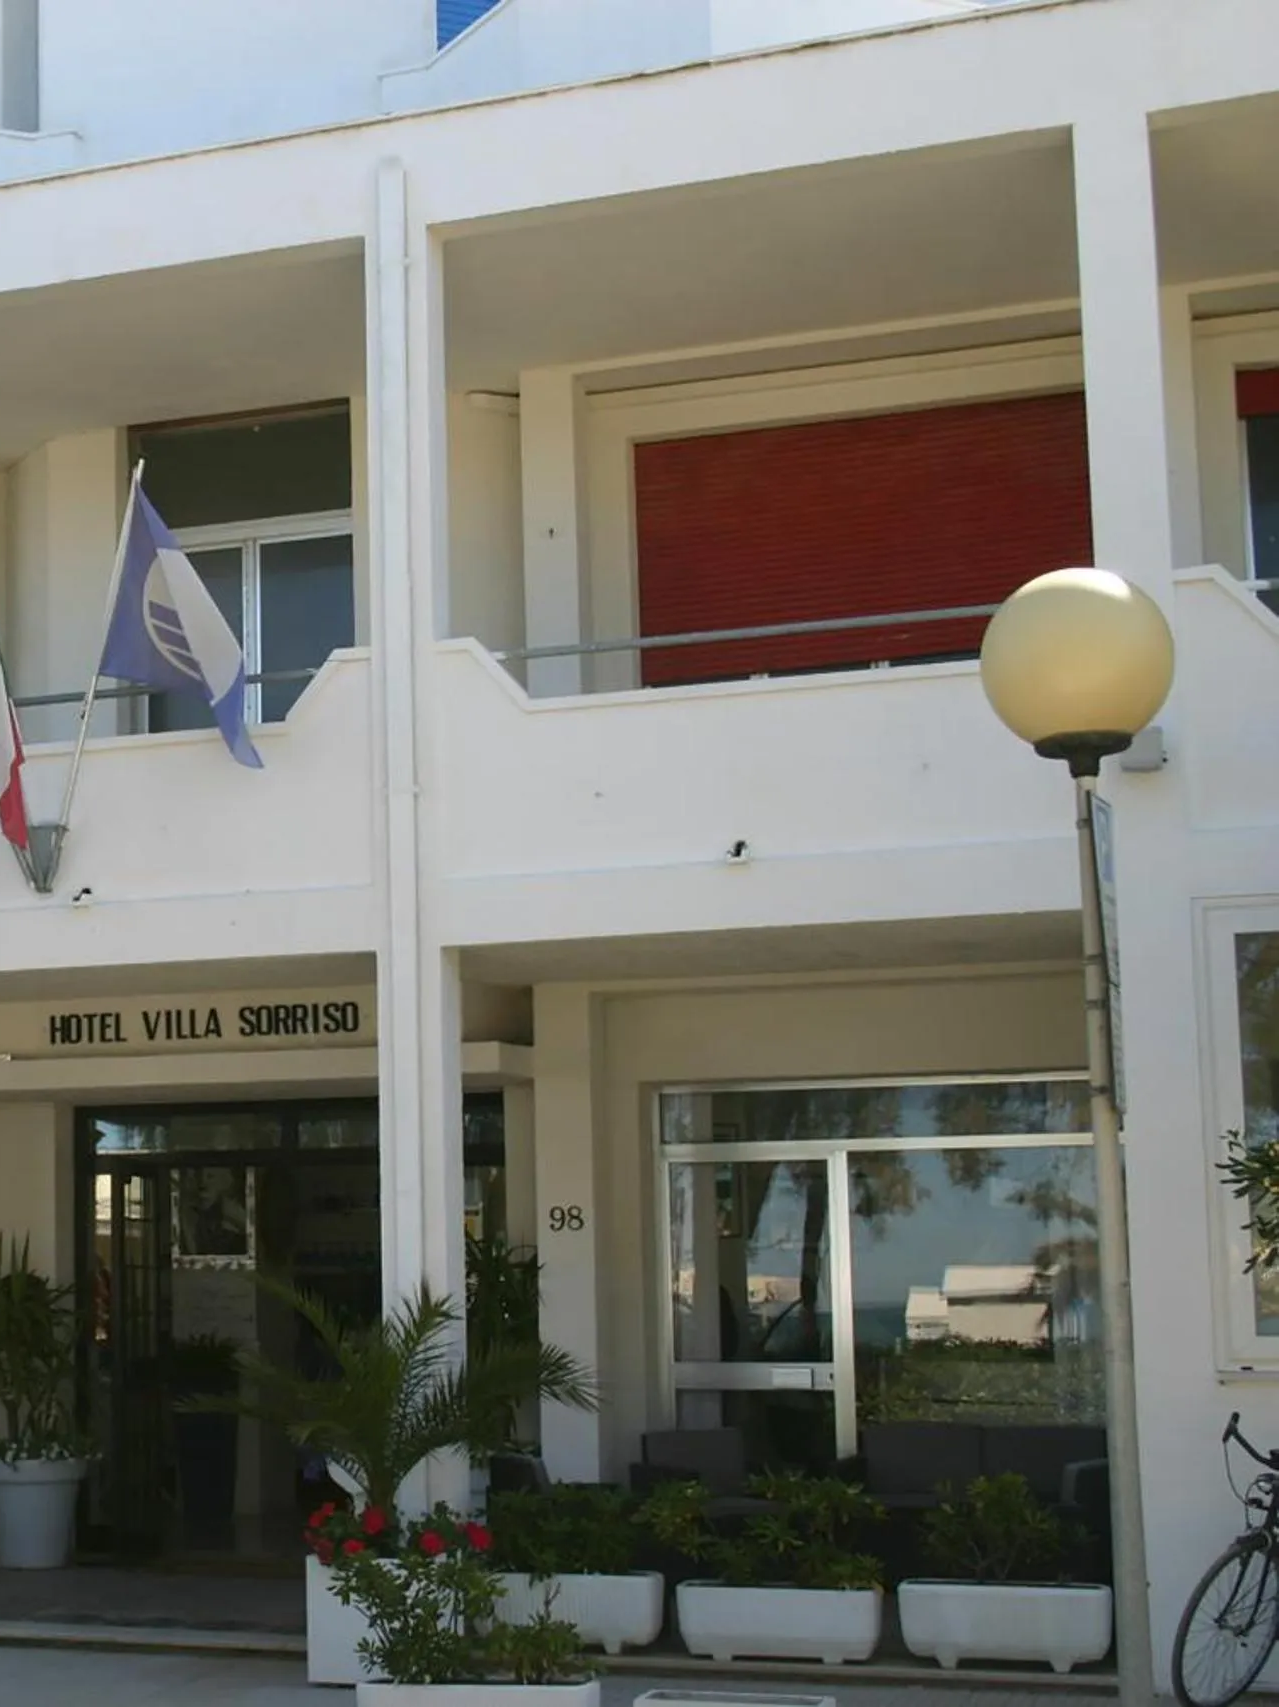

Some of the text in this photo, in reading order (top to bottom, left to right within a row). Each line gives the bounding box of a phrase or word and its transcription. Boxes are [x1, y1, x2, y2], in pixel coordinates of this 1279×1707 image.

[49, 1001, 360, 1046] HOTEL VILLA SORRISO
[549, 1205, 585, 1232] 98
